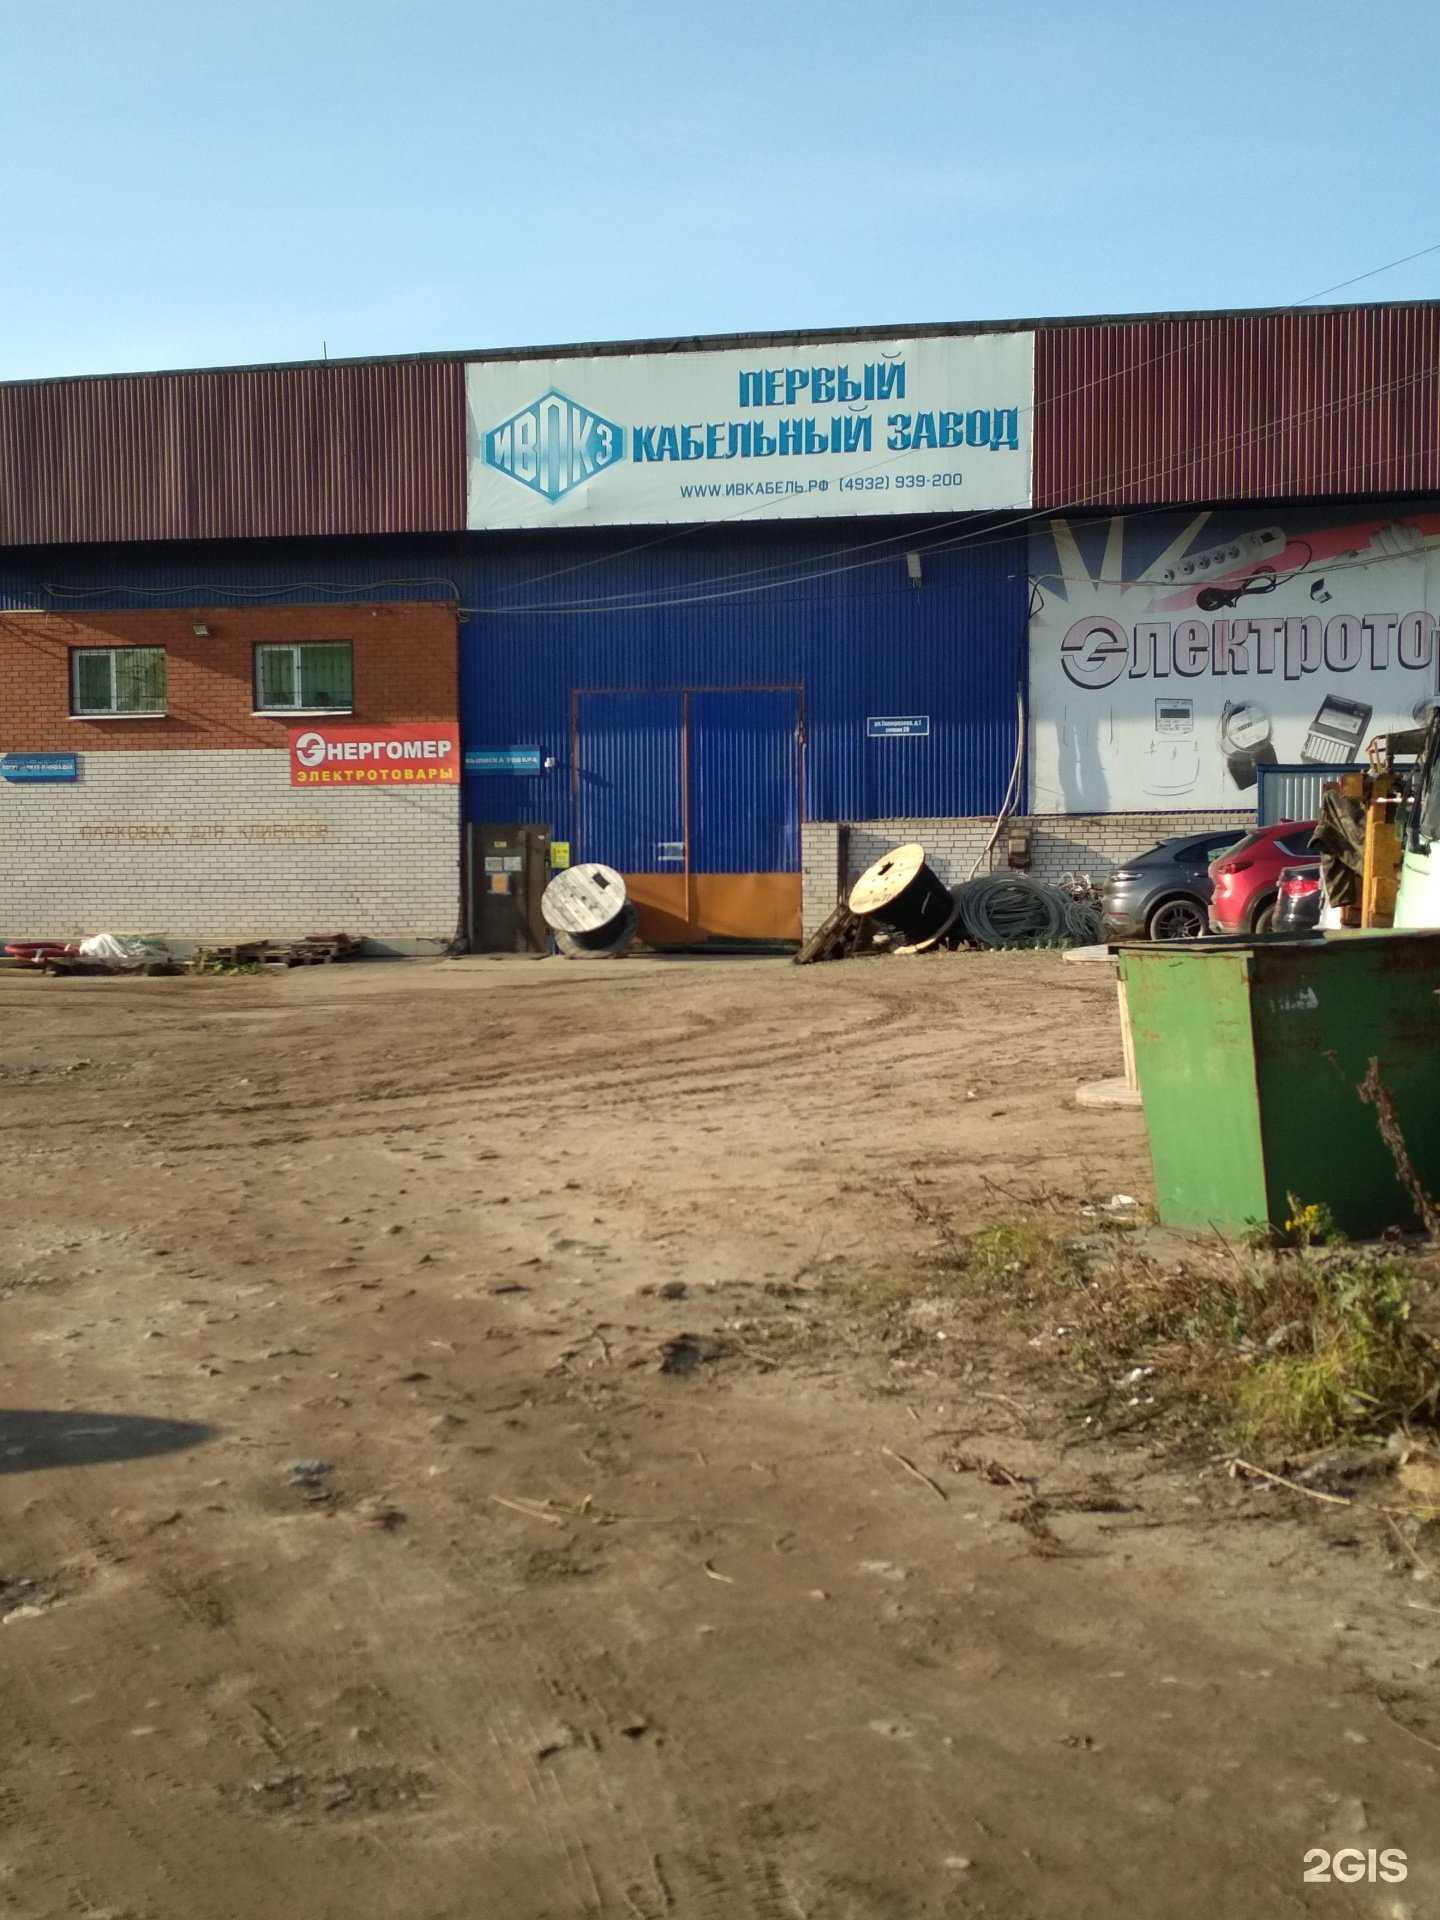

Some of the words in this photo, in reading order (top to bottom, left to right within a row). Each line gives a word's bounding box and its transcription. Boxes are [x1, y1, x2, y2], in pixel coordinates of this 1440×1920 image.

[738, 351, 906, 408] ПЕРВЫЙ
[632, 404, 873, 464] КАБЕЛЬНЫЙ
[886, 406, 1019, 451] ЗАВОД
[680, 479, 829, 498] WWW.ИВКАБЕЛЬ.РФ
[839, 475, 890, 492] (4932)
[895, 473, 963, 489] 939-200
[296, 732, 452, 767] ЭНЕРГОМЕР
[296, 768, 453, 782] ЭЛЕКТРОТОВАРЫ
